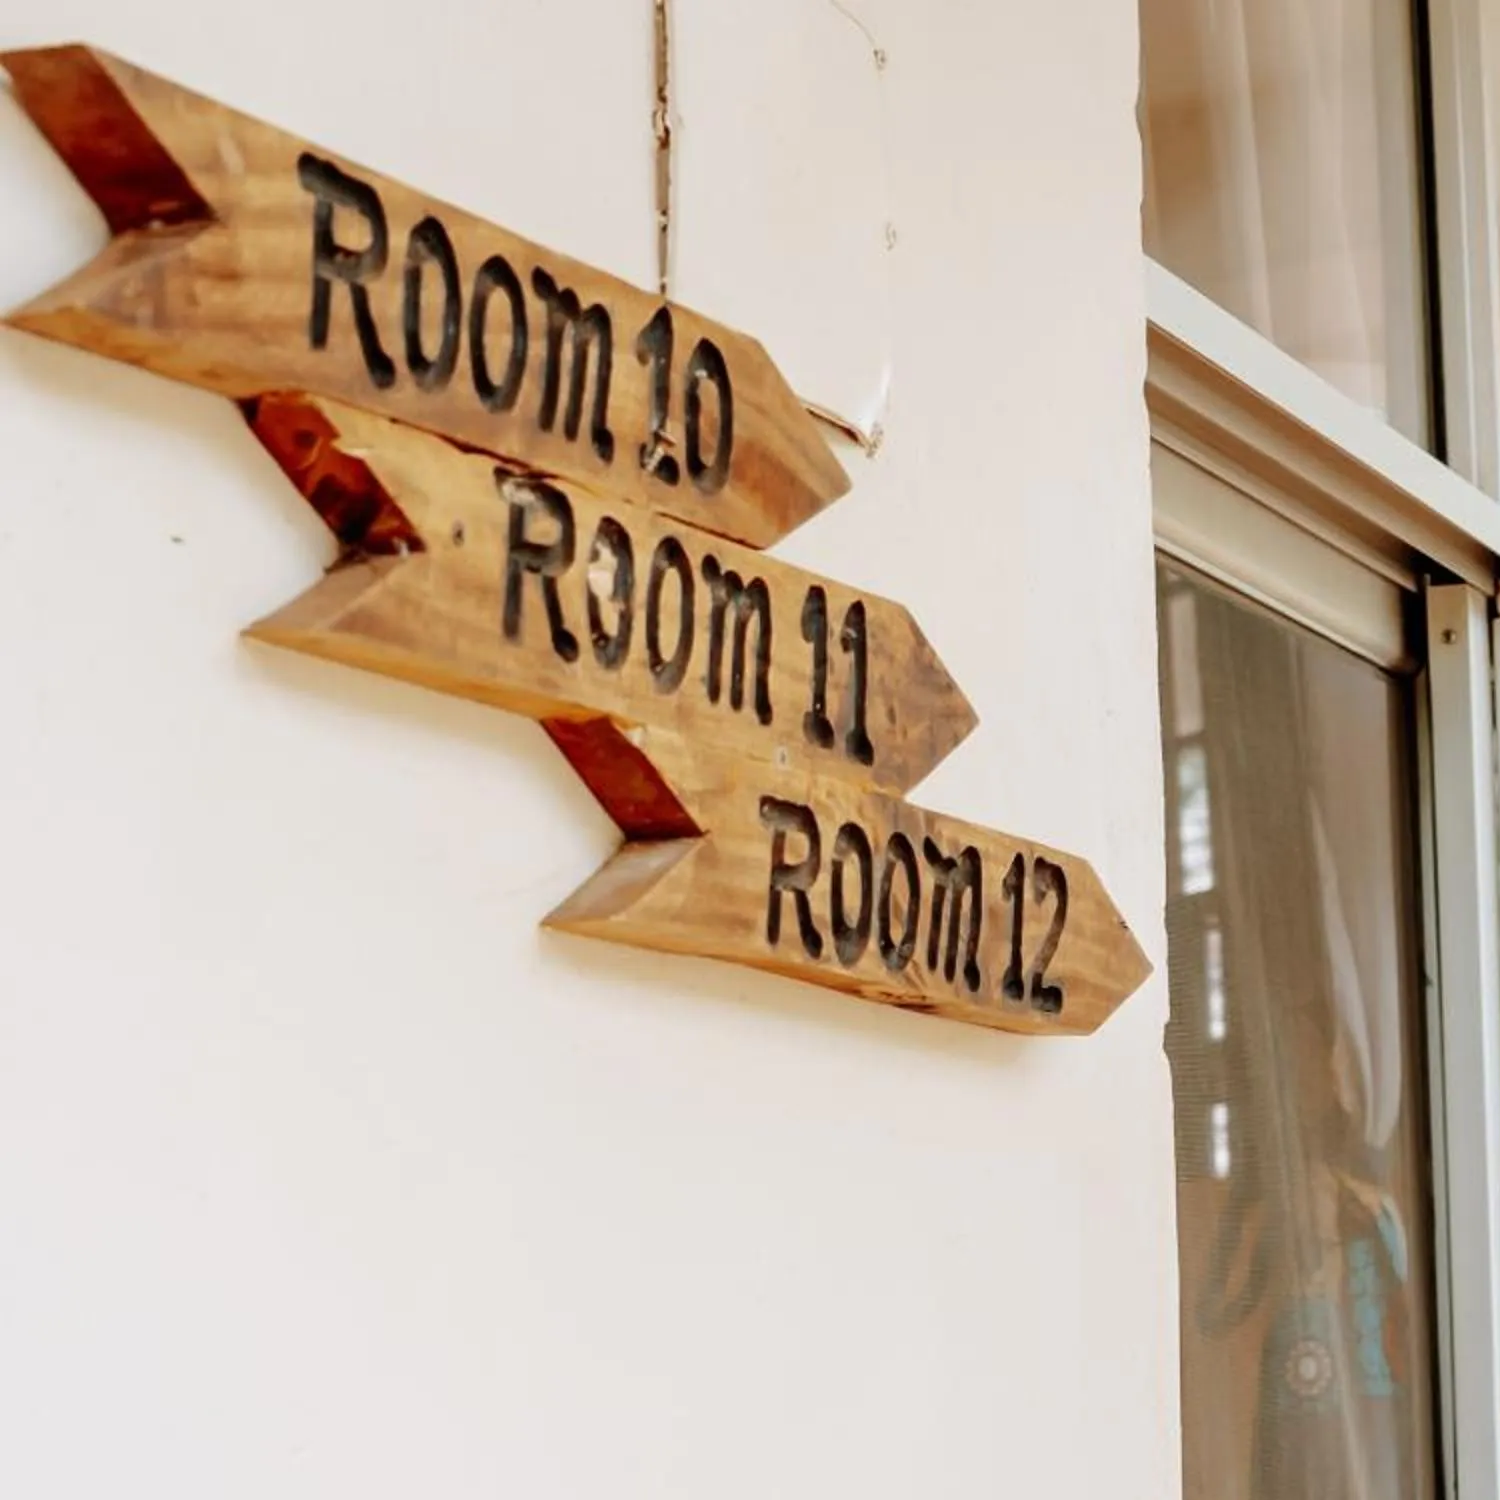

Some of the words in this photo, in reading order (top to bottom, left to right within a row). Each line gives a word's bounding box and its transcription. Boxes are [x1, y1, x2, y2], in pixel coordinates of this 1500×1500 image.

[635, 306, 733, 495] 10
[801, 584, 874, 766] 11
[1002, 852, 1069, 1014] 12
